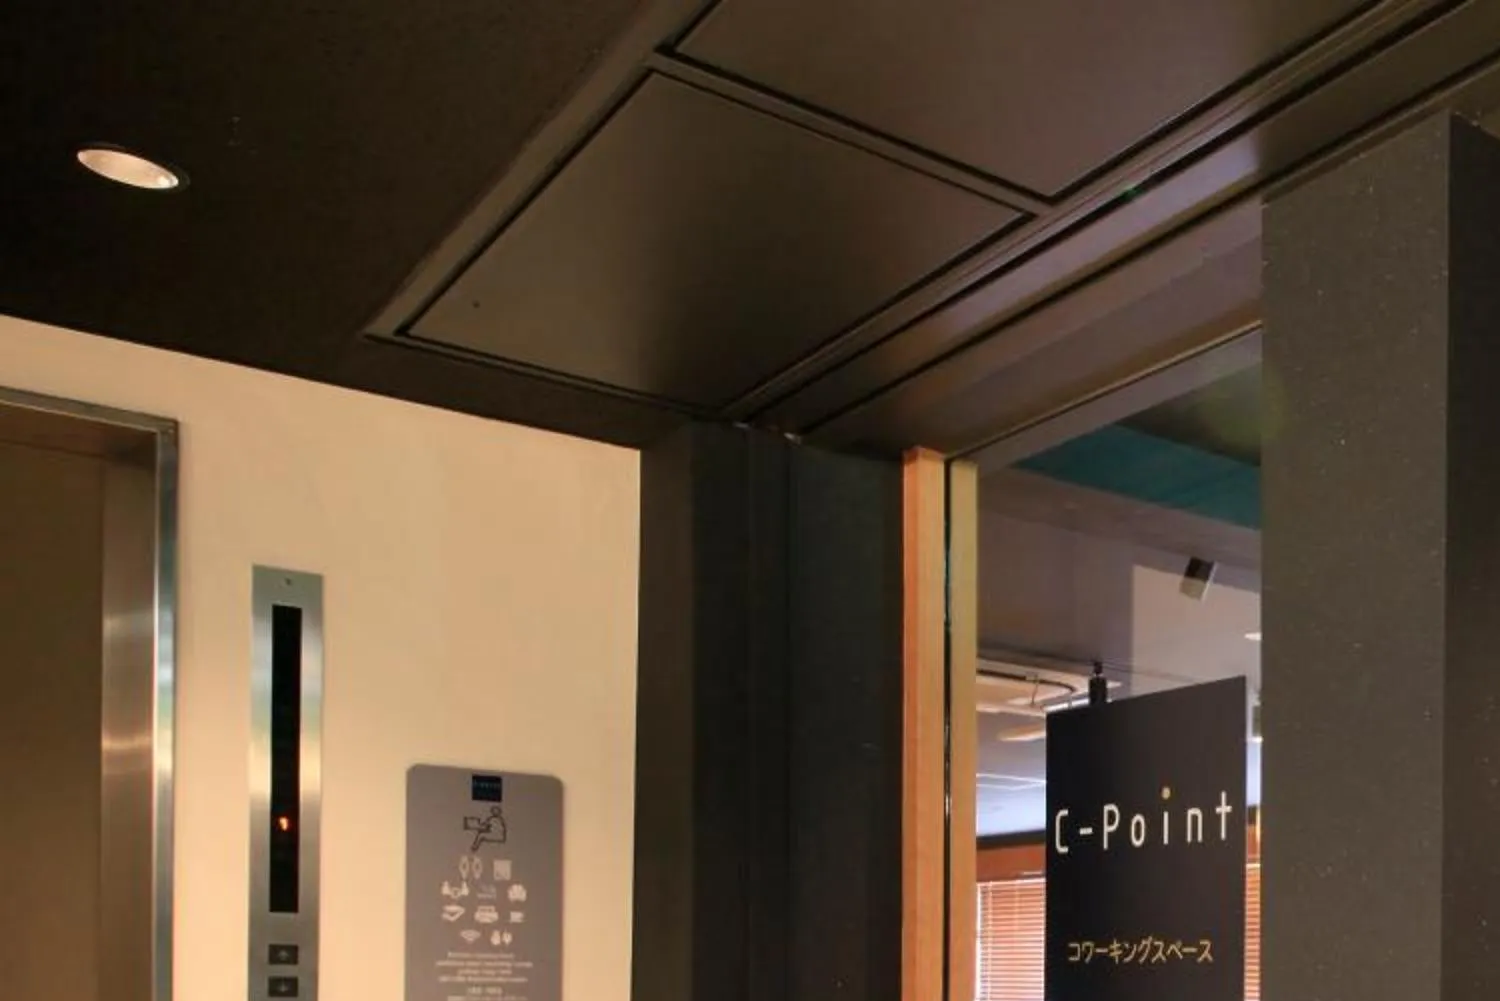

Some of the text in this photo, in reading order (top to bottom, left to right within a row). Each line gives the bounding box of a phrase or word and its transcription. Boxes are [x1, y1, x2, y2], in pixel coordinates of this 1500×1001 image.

[1054, 785, 1233, 855] C-Point
[1067, 935, 1214, 966] コワーキングスペース
